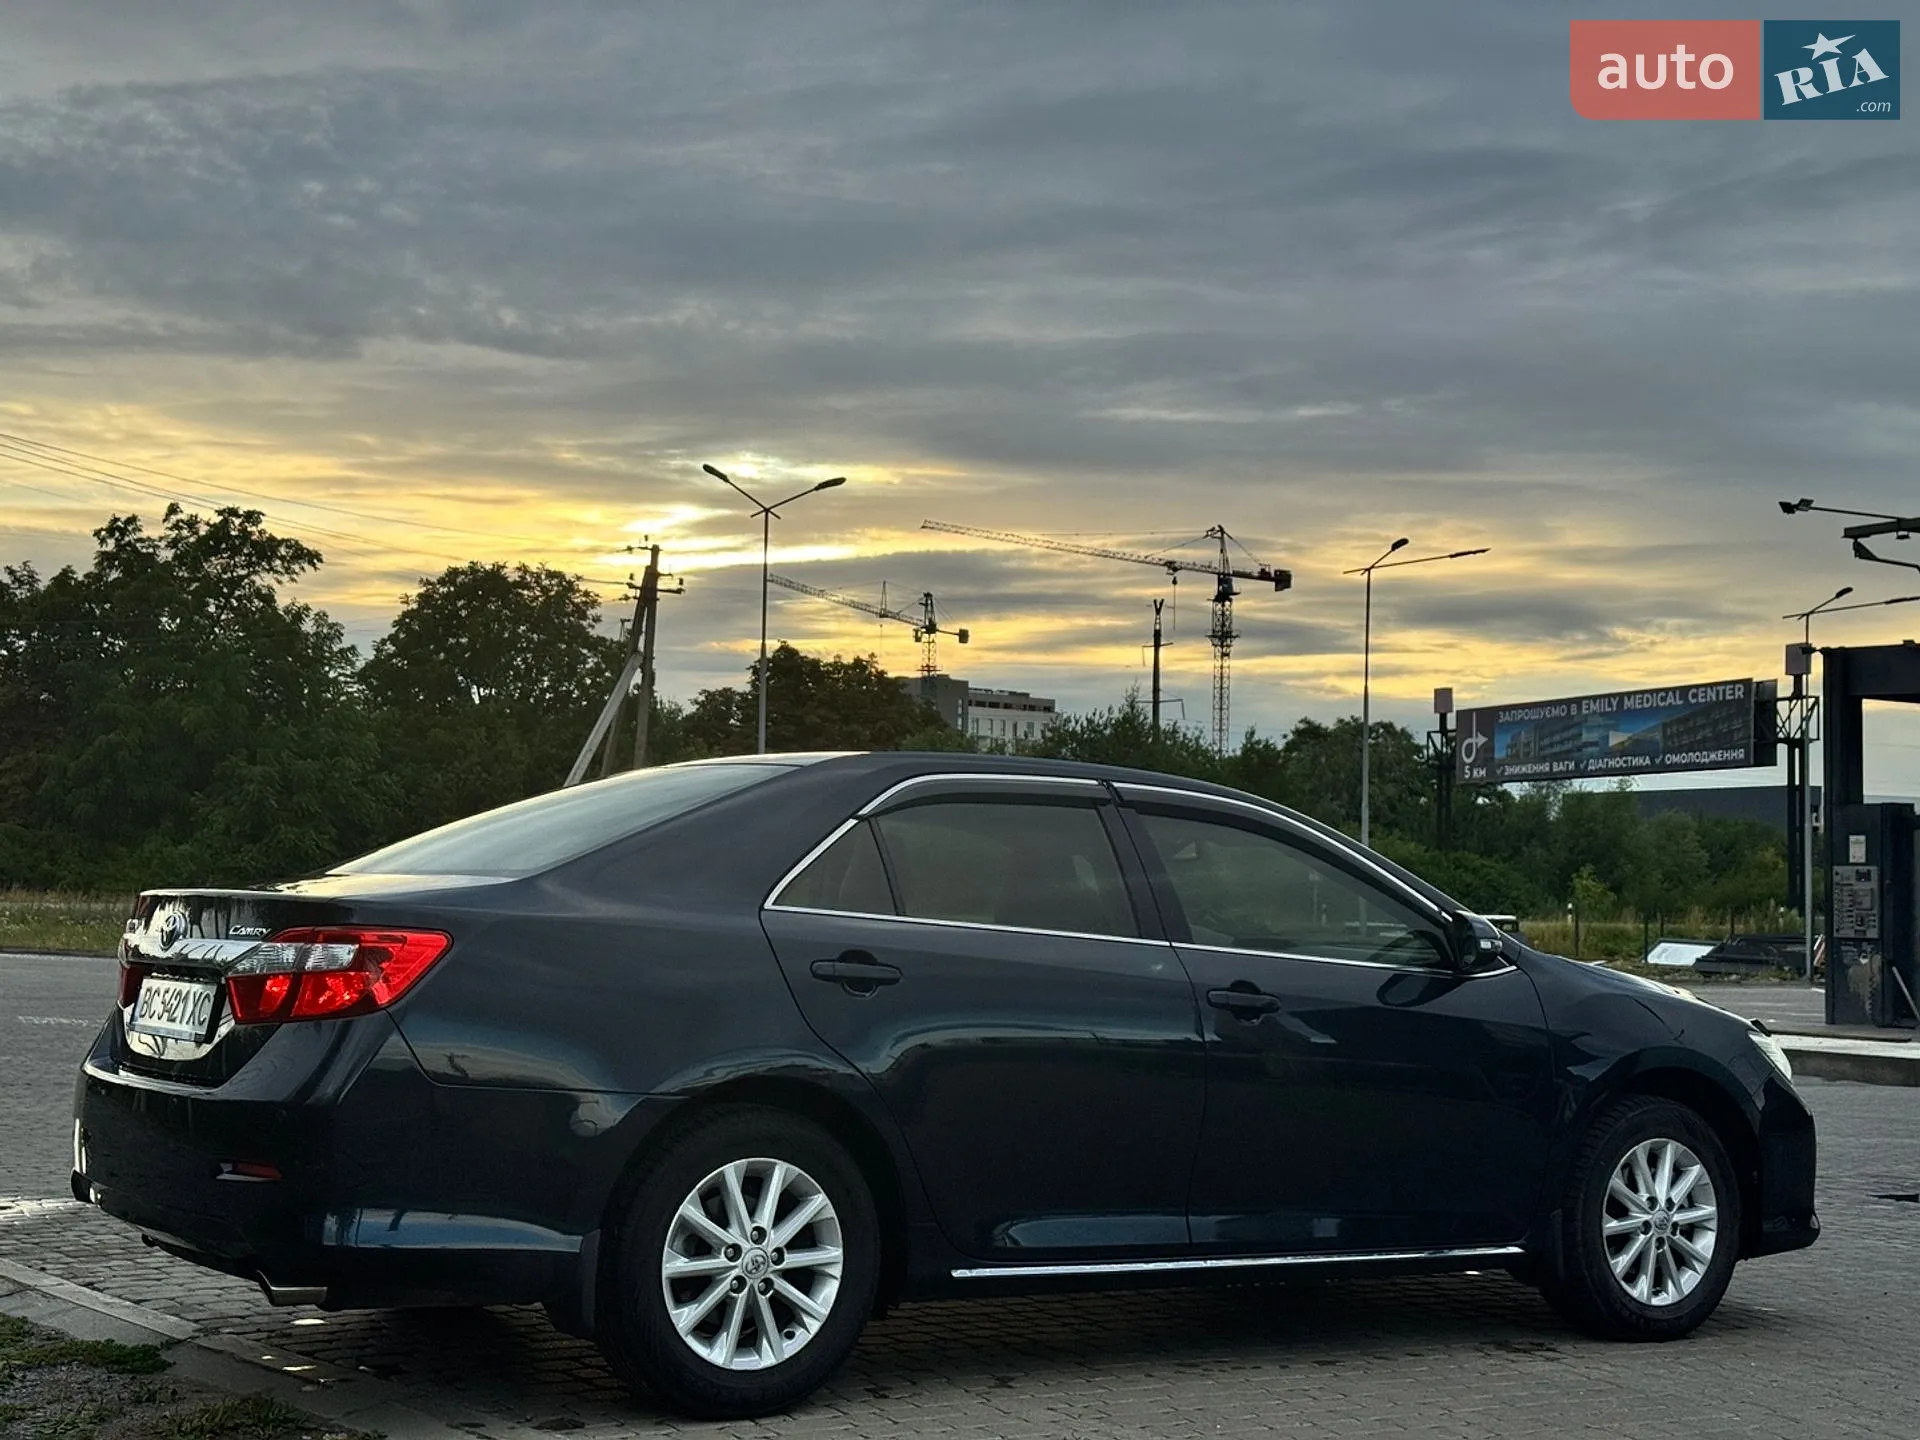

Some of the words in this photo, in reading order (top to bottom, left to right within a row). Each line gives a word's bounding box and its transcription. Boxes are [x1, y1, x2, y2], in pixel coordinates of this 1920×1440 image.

[1499, 704, 1568, 722] ЗАПРОШУЄМО
[1582, 697, 1619, 715] EMILY
[1623, 690, 1683, 710] MEDICAL
[1688, 684, 1745, 704] CENTER
[1464, 764, 1470, 779] 5
[1504, 762, 1550, 776] ЗНИЖЕННЯ
[1552, 760, 1575, 773] ВАГИ
[1587, 755, 1651, 772] ДІАГНОСТИКА
[1664, 748, 1745, 766] ОМОЛОДЖЕННЯ
